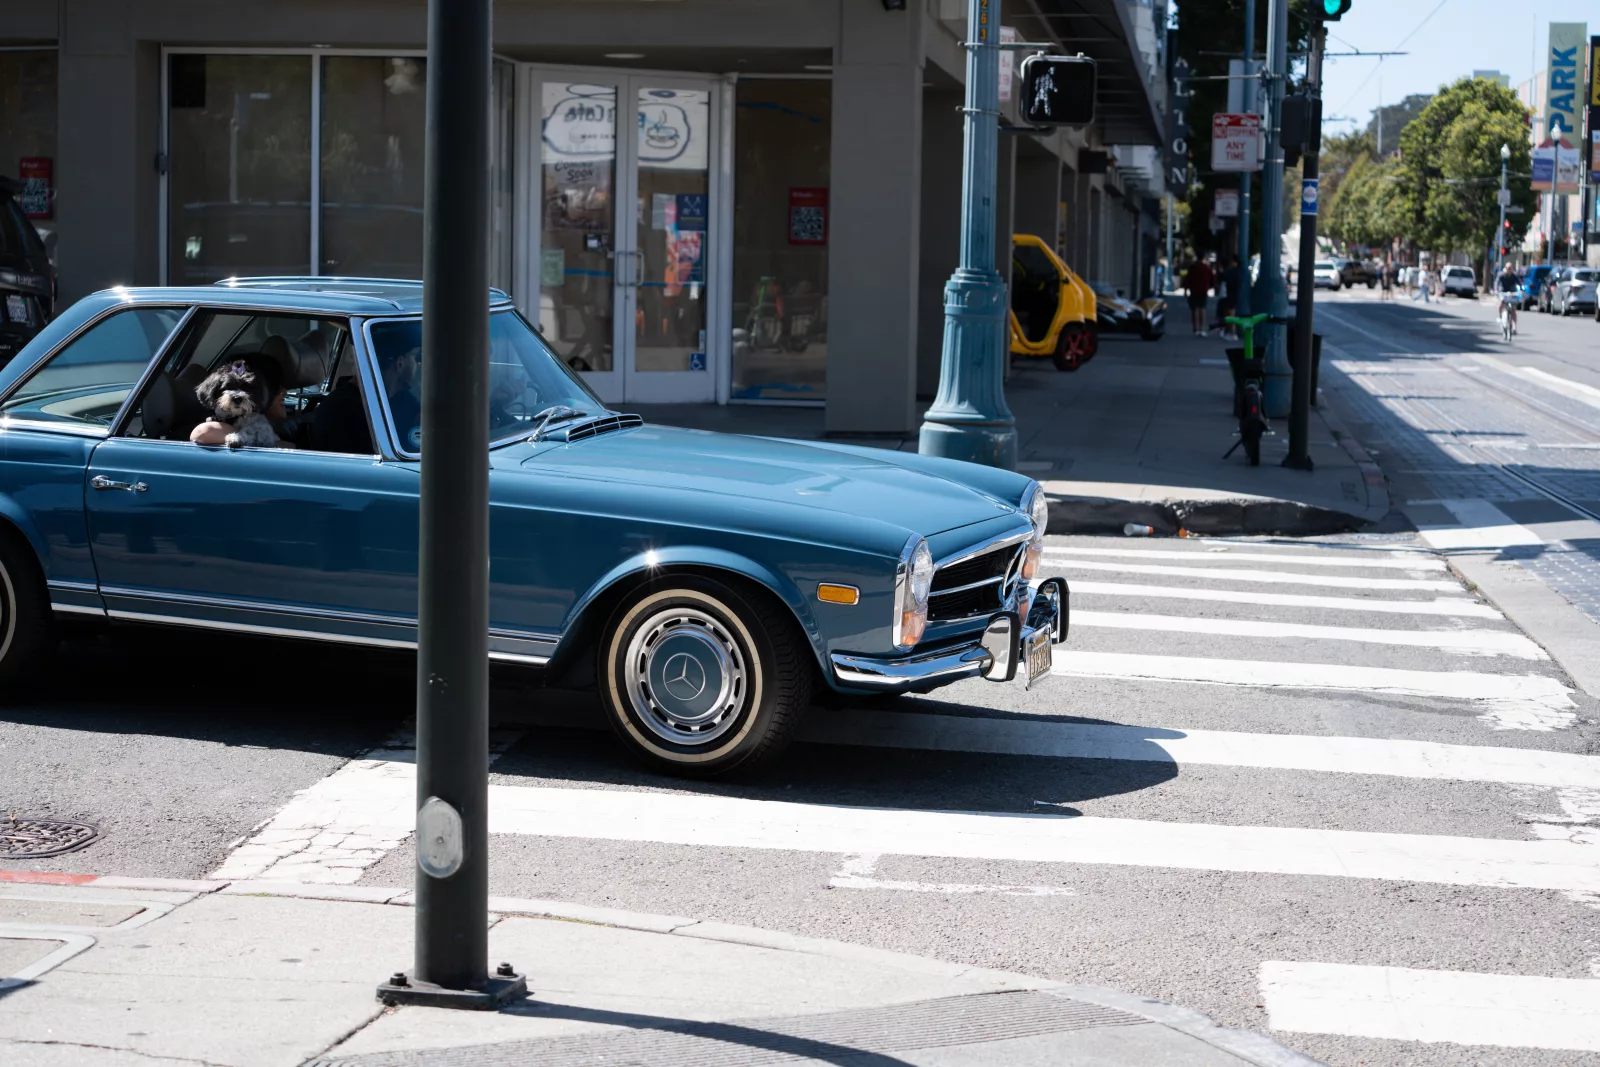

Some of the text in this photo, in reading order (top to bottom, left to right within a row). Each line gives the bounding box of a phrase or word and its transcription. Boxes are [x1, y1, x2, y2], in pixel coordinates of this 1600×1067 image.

[1549, 46, 1577, 133] PARK
[1214, 127, 1227, 138] NO
[1226, 141, 1245, 151] ANY
[1226, 151, 1245, 161] TIME
